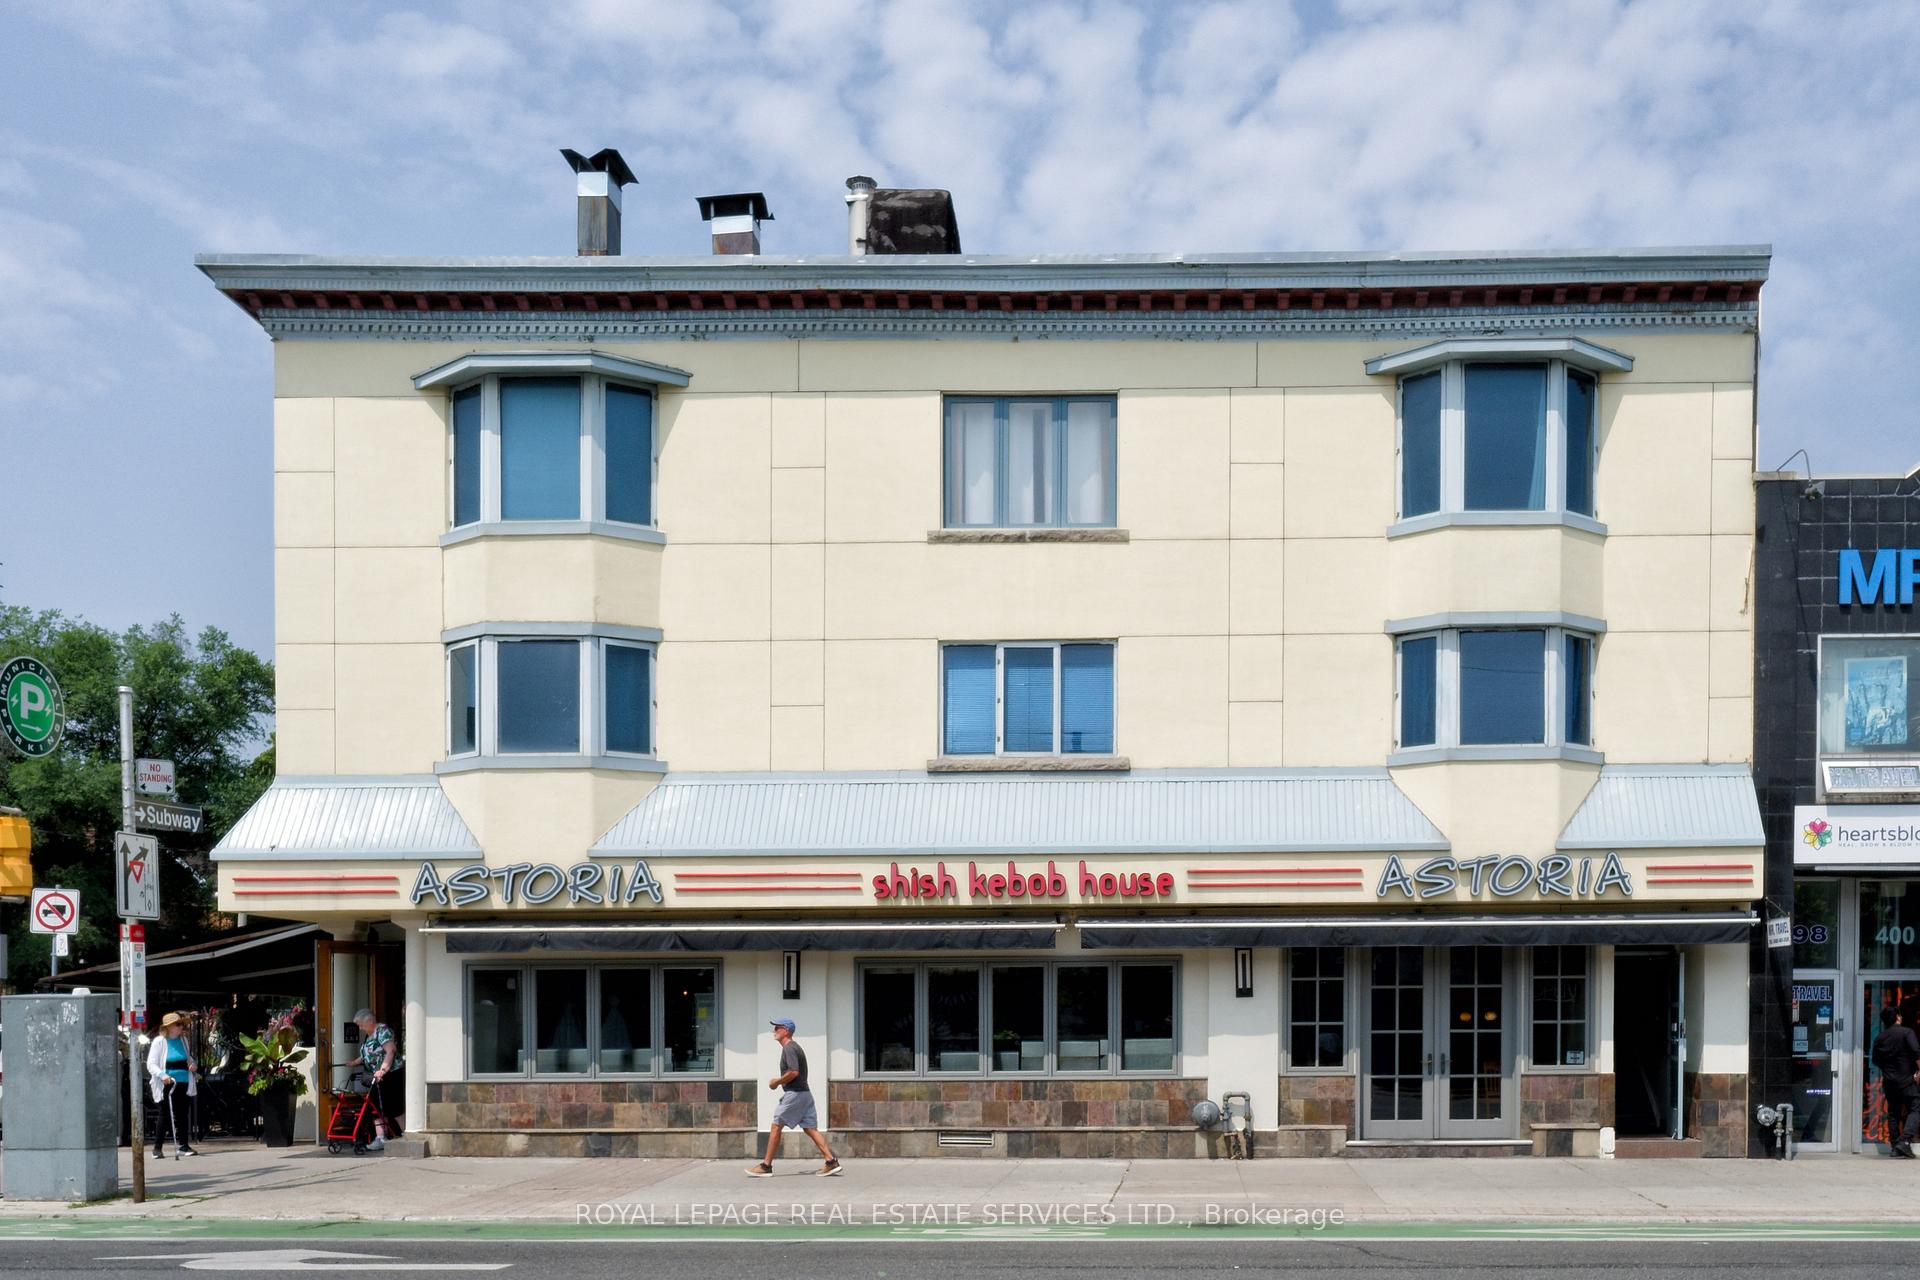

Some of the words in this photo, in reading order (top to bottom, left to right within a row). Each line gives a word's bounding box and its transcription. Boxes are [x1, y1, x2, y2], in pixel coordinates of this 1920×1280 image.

[0, 661, 60, 711] MUNICIPAL
[20, 681, 45, 719] P
[1, 708, 60, 752] PARKING
[140, 773, 173, 783] STANDING
[149, 763, 161, 772] NO
[146, 805, 200, 833] Subway
[410, 860, 662, 906] ASTORIA
[872, 862, 956, 898] shish
[968, 860, 1067, 897] kebob
[1079, 860, 1175, 896] house
[1376, 852, 1633, 898] ASTORIA
[1875, 926, 1915, 945] 400
[1793, 985, 1832, 1001] TRAVEL
